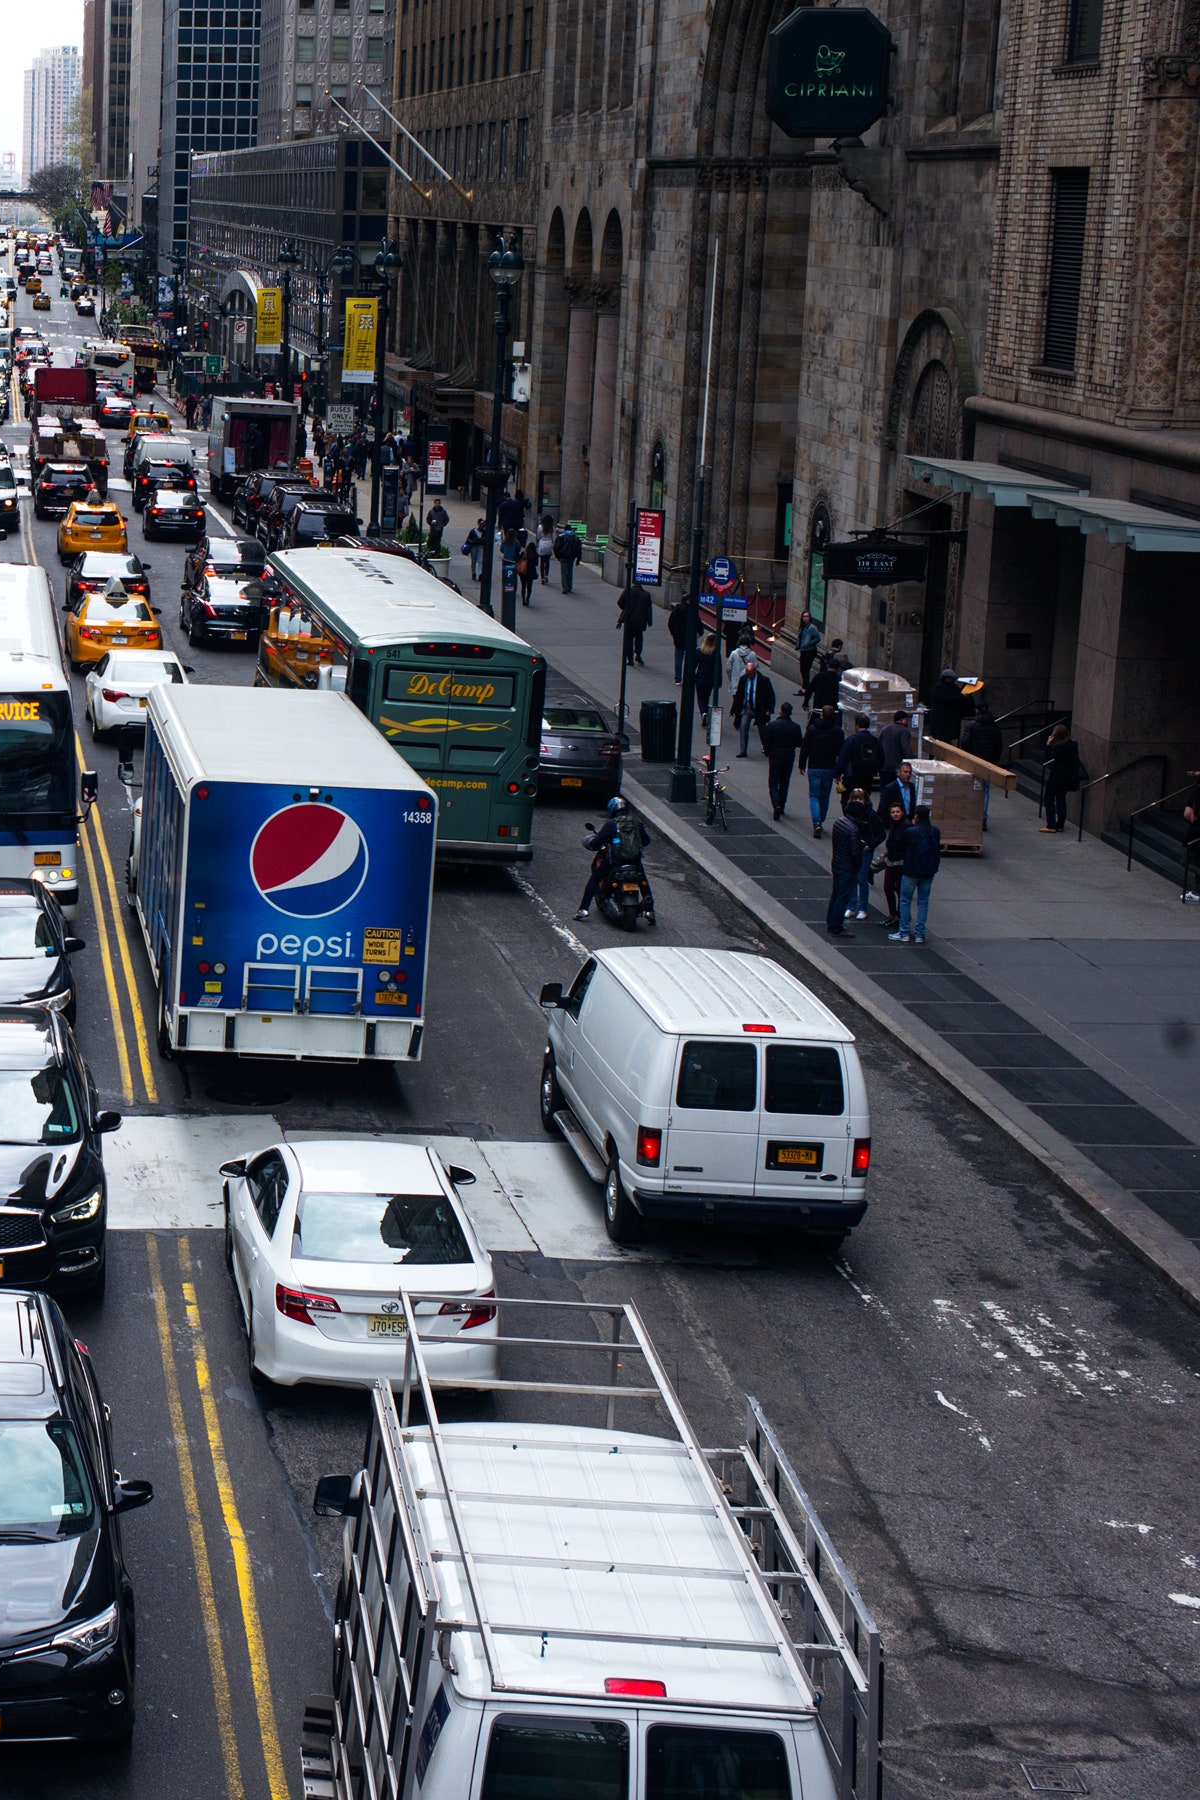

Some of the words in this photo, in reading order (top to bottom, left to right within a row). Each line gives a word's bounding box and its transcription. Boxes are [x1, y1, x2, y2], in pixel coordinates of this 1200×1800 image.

[785, 83, 872, 96] CIPRIANI
[700, 596, 715, 604] M42
[387, 650, 400, 658] 541
[402, 811, 432, 824] 14358
[365, 929, 400, 938] CAUTION
[256, 931, 352, 962] pepsi
